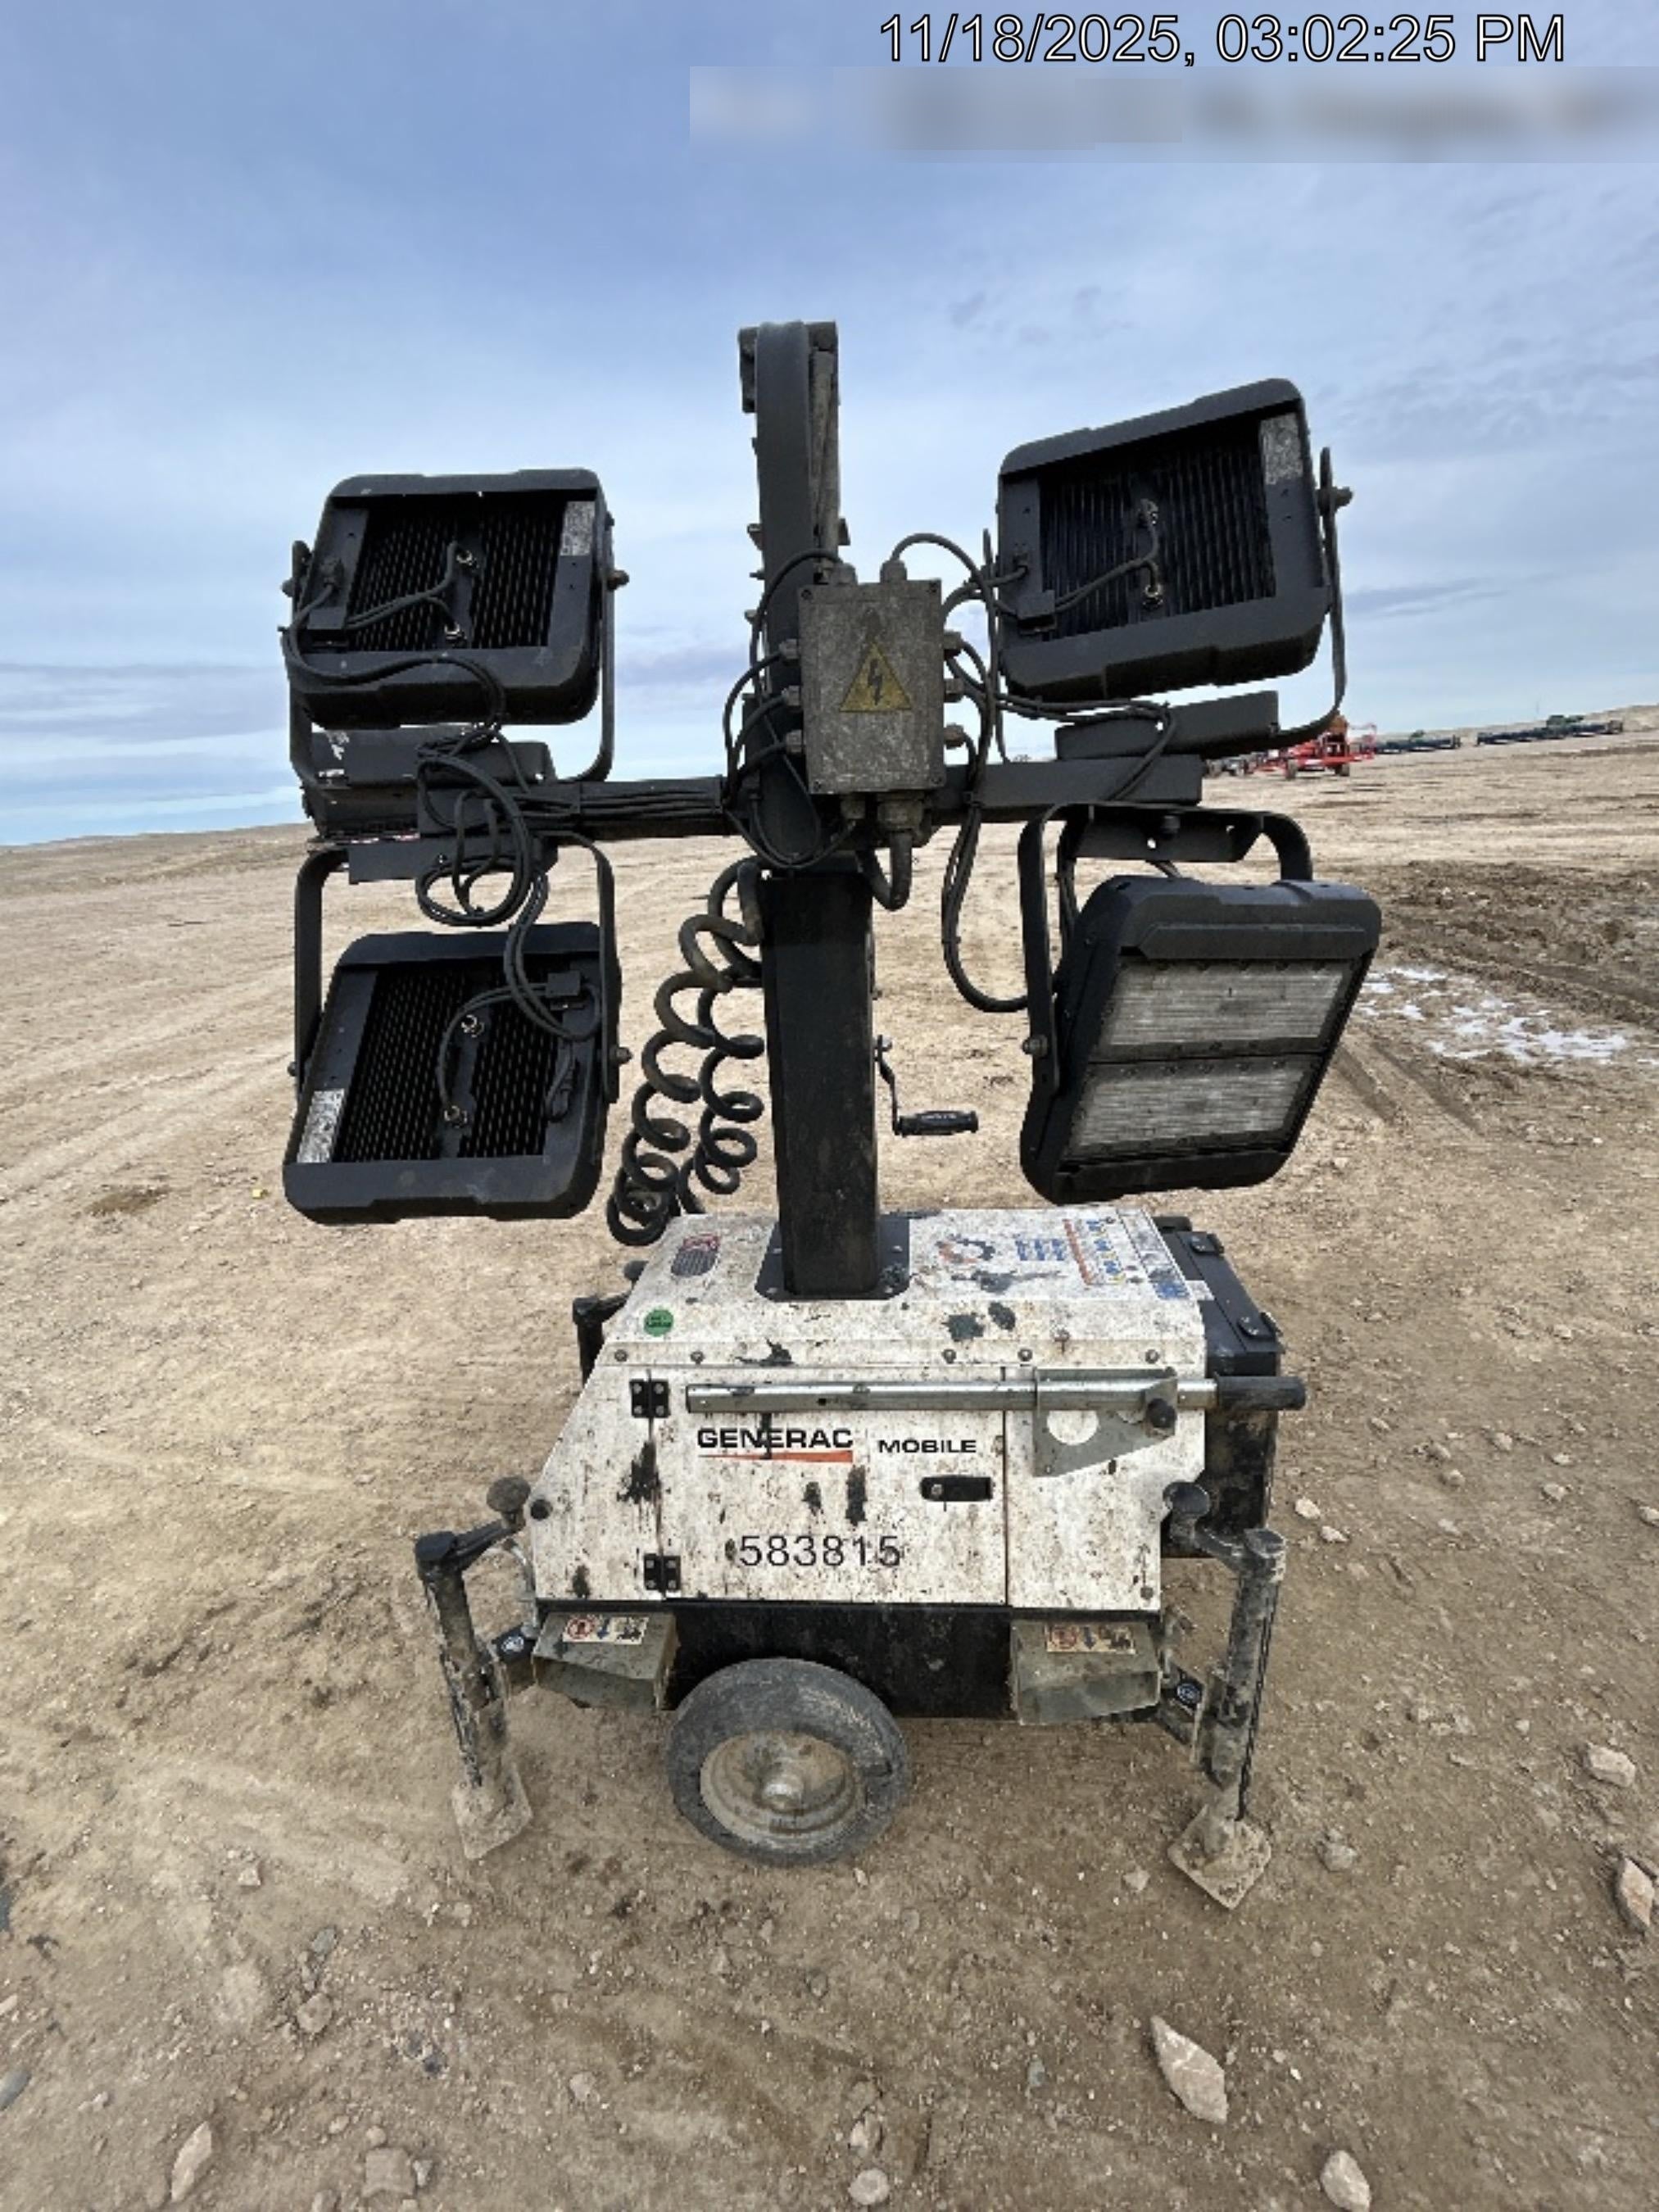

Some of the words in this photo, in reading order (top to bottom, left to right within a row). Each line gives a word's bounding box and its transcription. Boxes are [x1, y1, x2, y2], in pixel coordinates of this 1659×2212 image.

[697, 1427, 854, 1449] GENERAC
[878, 1439, 977, 1453] MOBILE
[739, 1535, 901, 1566] 583815
